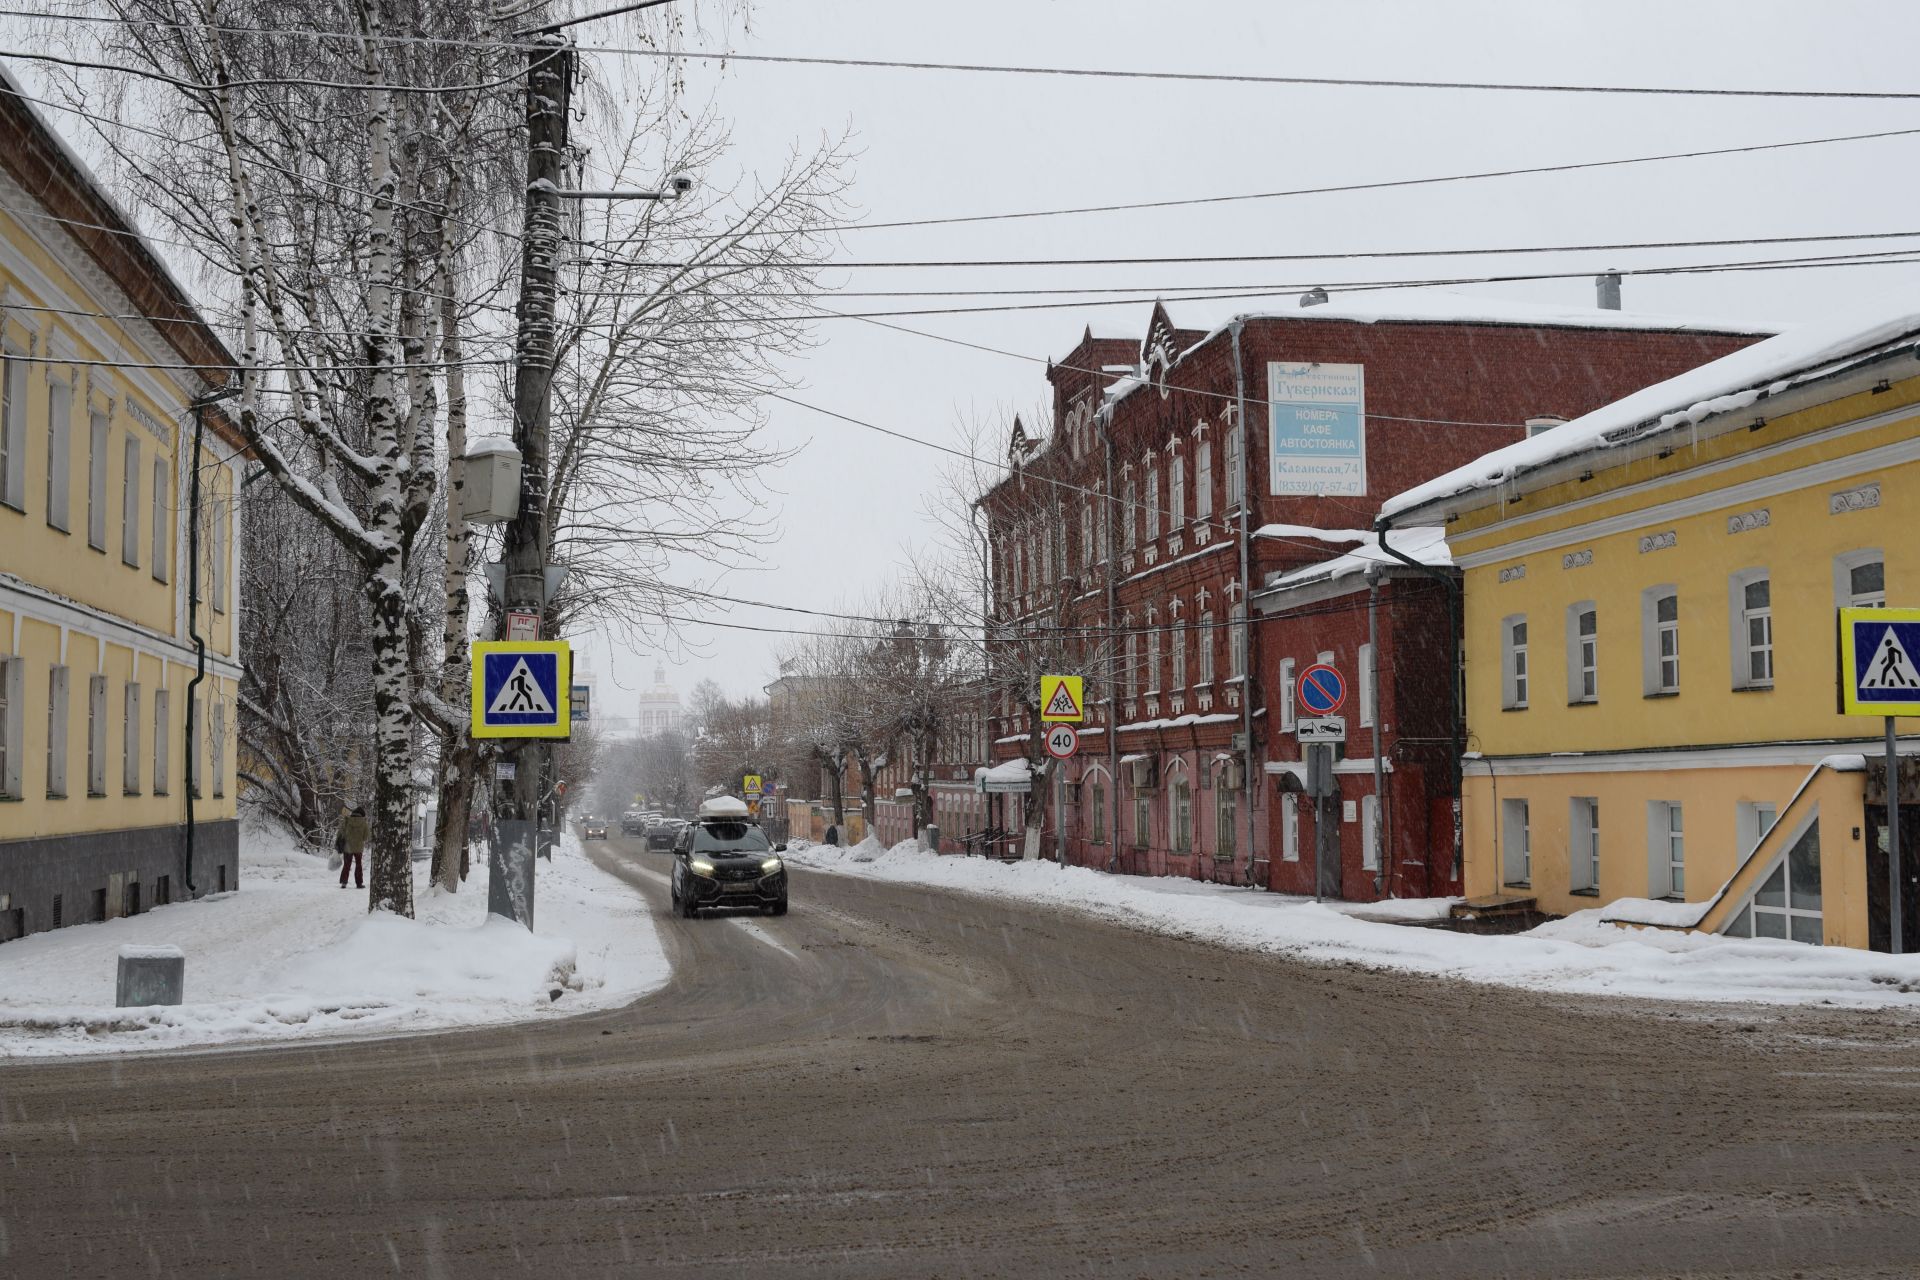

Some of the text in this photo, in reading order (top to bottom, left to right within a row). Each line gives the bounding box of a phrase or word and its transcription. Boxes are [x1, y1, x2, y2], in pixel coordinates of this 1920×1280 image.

[1277, 381, 1357, 398] Губернская
[1296, 409, 1339, 421] НОМЕРА
[1303, 425, 1332, 435] КАФЕ
[1280, 438, 1356, 449] АВТОСТОЯНКА
[1052, 734, 1071, 747] 40
